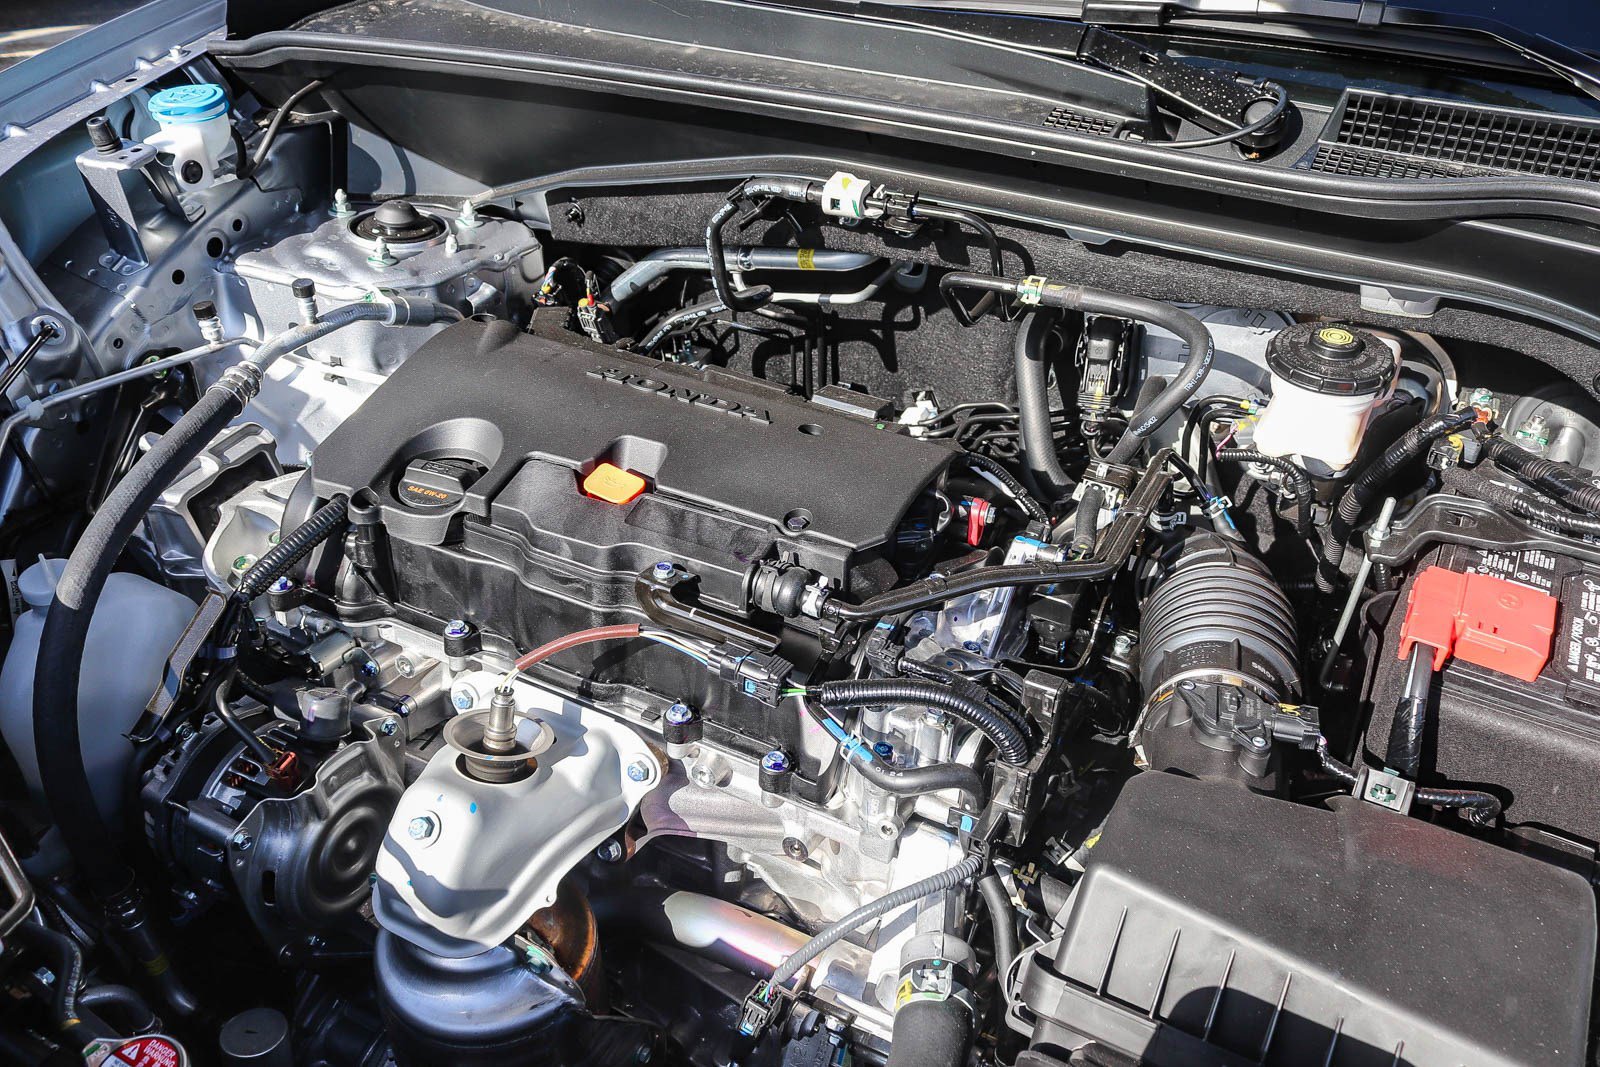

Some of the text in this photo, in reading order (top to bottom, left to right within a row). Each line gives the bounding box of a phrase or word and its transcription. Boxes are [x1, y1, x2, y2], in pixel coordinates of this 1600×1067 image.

[586, 368, 772, 424] HONDA
[407, 485, 448, 499] SAE 0W-20
[143, 1045, 175, 1067] WARNUNG
[149, 1040, 176, 1059] DANGER
